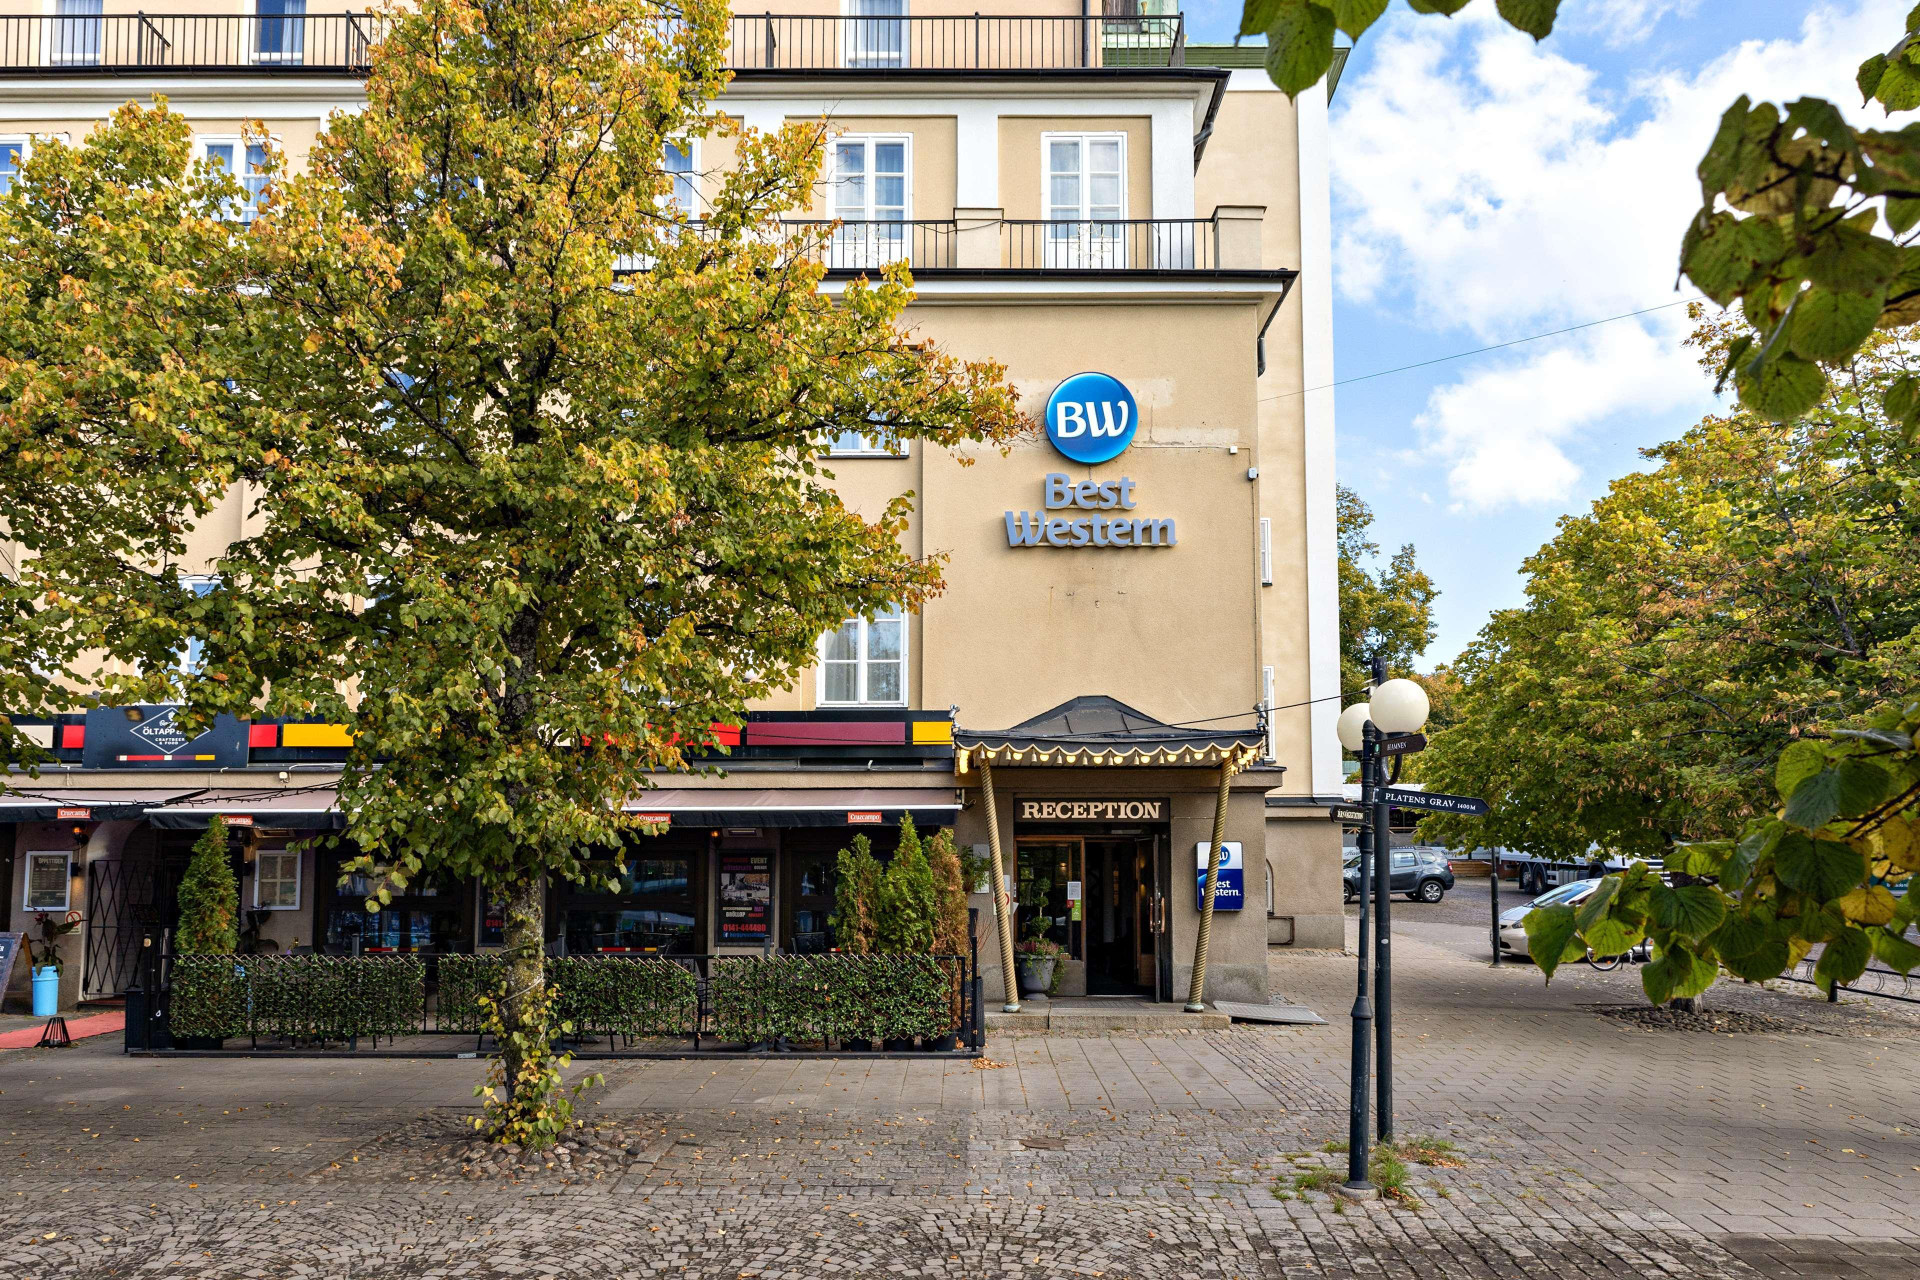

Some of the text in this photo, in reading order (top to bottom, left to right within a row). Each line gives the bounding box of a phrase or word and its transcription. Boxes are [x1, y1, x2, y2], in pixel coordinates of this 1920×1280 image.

[1056, 400, 1129, 438] BW
[1045, 472, 1137, 509] Best
[1004, 510, 1179, 547] Western
[142, 726, 175, 735] ÖLTAPP
[1386, 742, 1407, 751] HAMNEN
[1385, 792, 1426, 804] PLATENS
[1429, 798, 1455, 807] GRAV
[1022, 801, 1162, 819] RECEPTION
[639, 814, 670, 822] Cruzcampo
[850, 813, 881, 822] Cruzcampo
[1216, 880, 1231, 888] est
